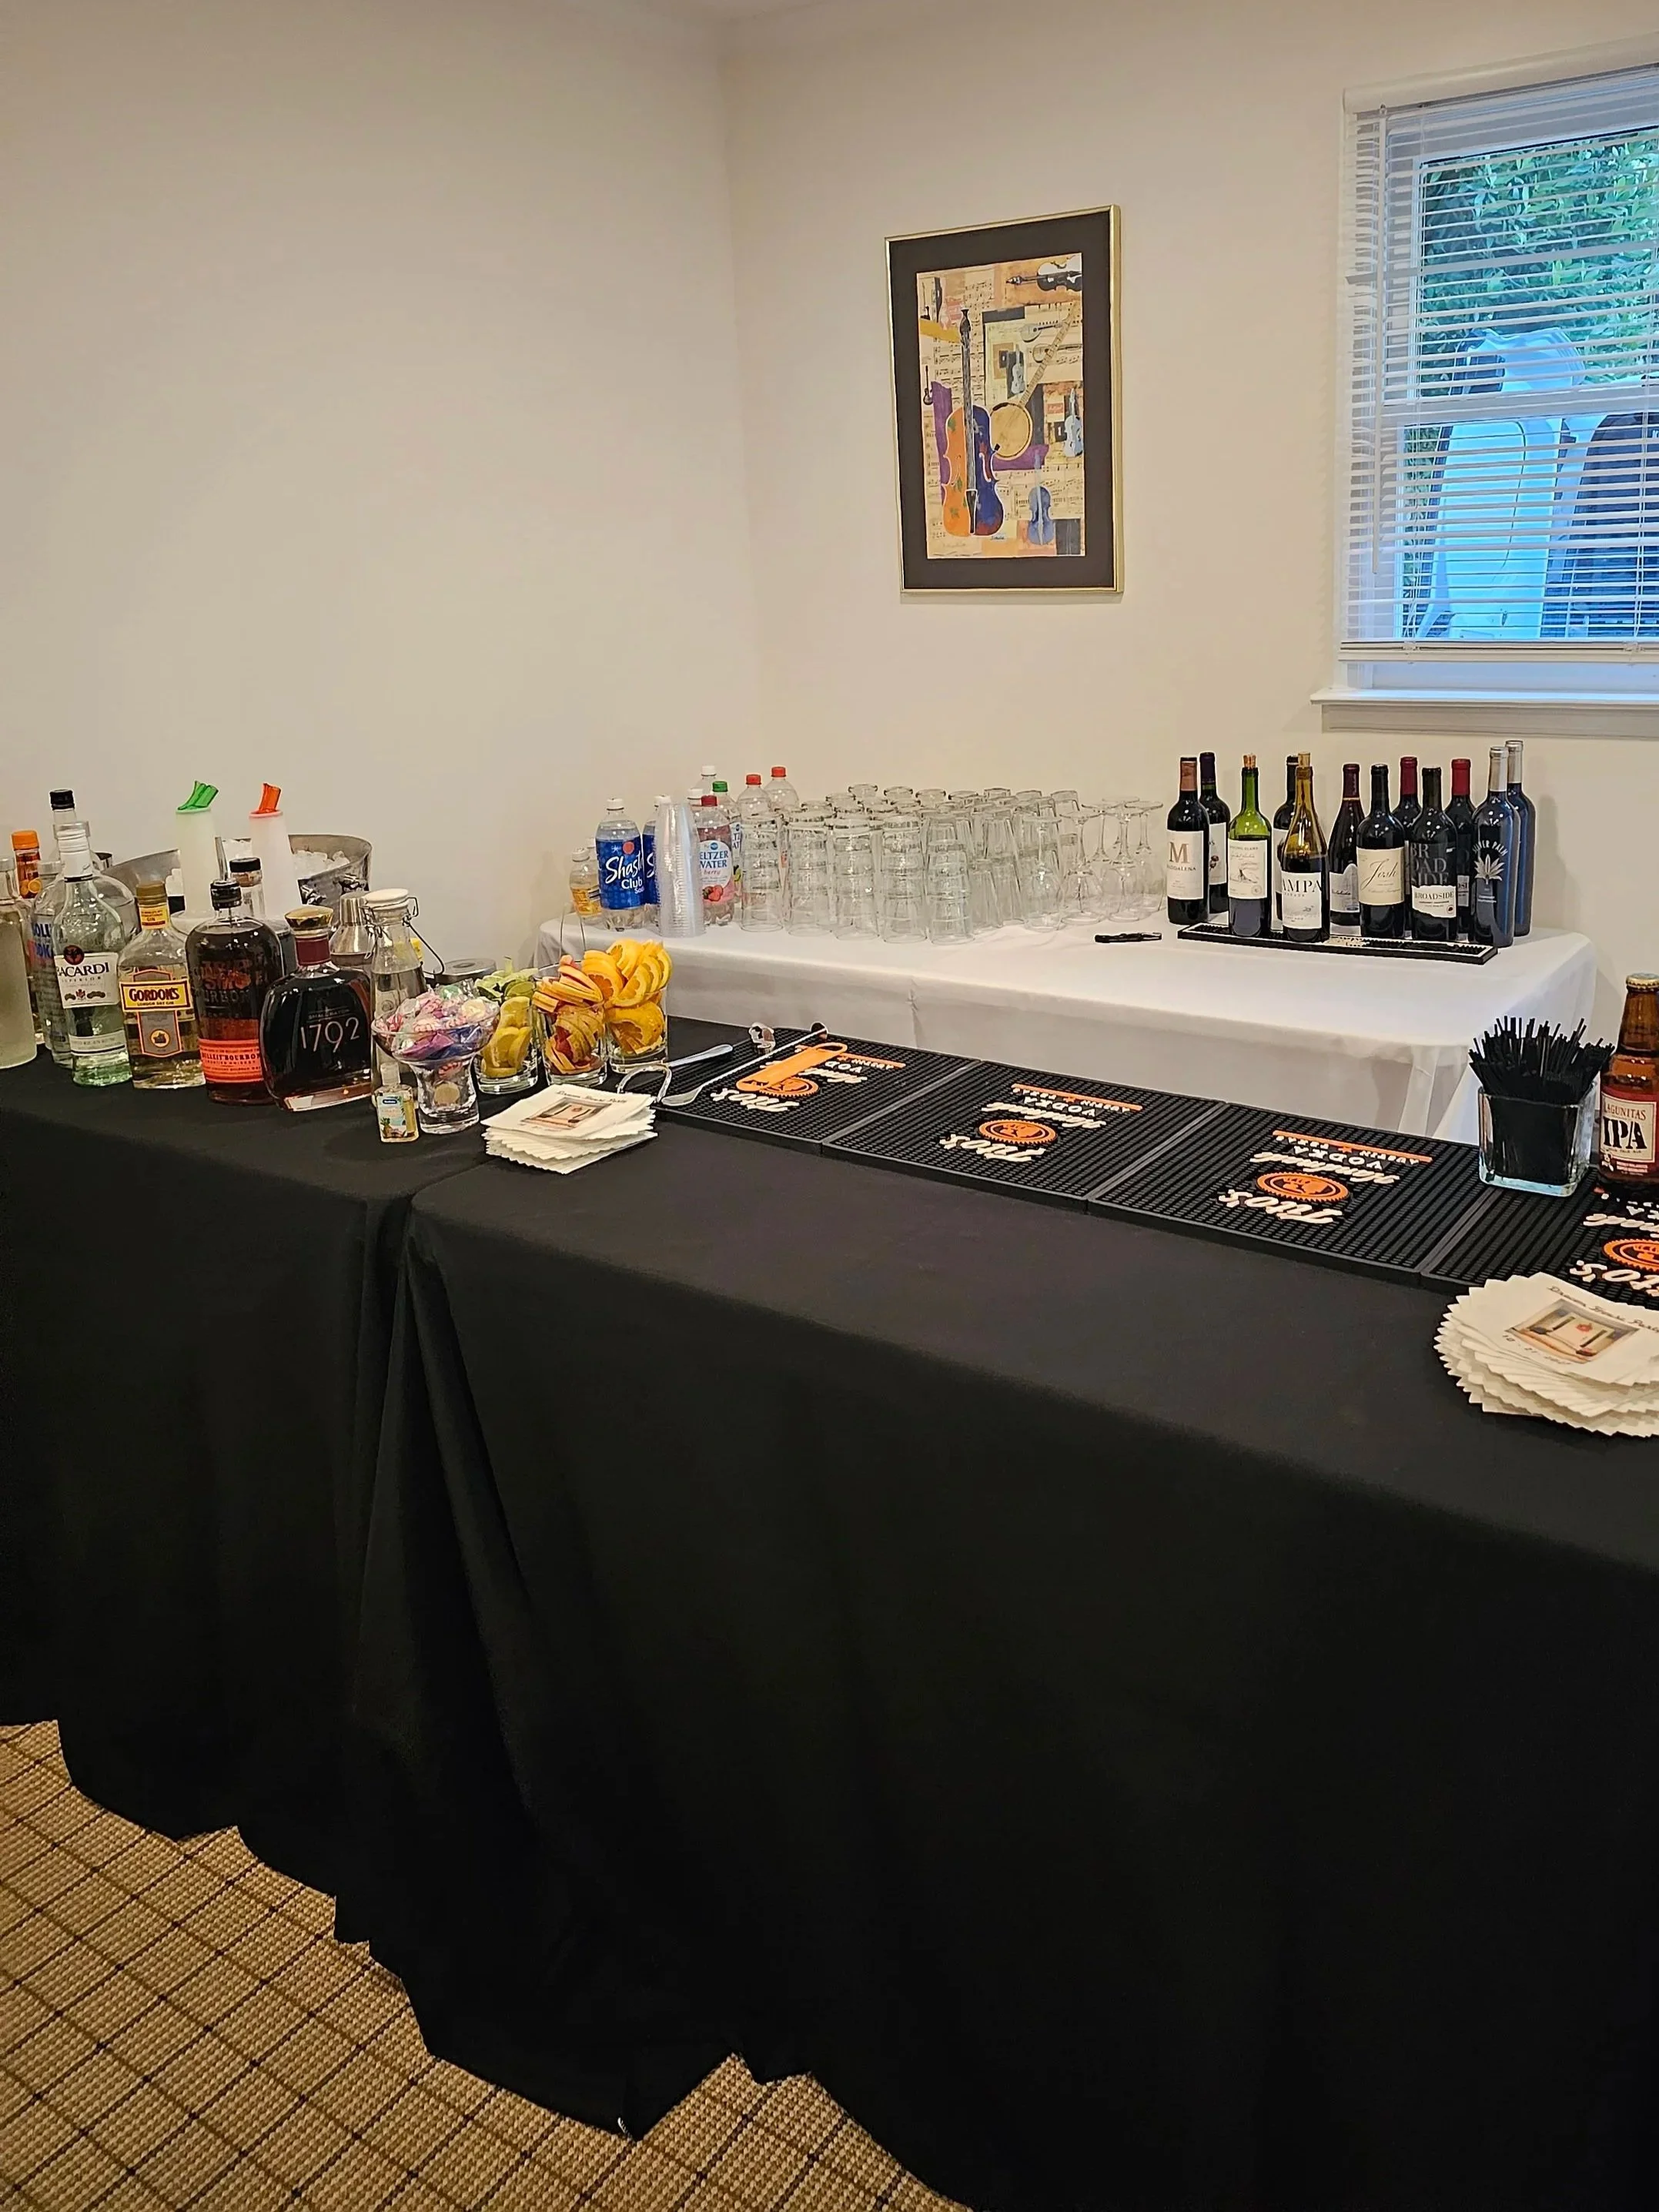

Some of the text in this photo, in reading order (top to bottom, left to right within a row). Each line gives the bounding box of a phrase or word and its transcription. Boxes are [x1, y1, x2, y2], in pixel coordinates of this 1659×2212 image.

[1169, 842, 1189, 864] M
[1492, 841, 1508, 856] PALM
[620, 877, 643, 889] Club
[1360, 858, 1399, 891] Josh
[1414, 891, 1454, 900] BROADSIDE
[129, 987, 180, 1002] GORDON'S
[300, 1016, 360, 1053] 1792
[824, 1059, 863, 1074] VOD
[1023, 1096, 1096, 1117] VODKA
[1080, 1099, 1131, 1113] AUSTIN
[1604, 1101, 1647, 1121] LAGUNITAS
[1602, 1116, 1648, 1150] IPA
[939, 1133, 1047, 1163] Tito's
[1275, 1135, 1420, 1166] AUSTIN TEXAS
[1293, 1145, 1383, 1170] VODKA
[1249, 1151, 1400, 1184] Handmade
[1218, 1189, 1343, 1224] Tito's
